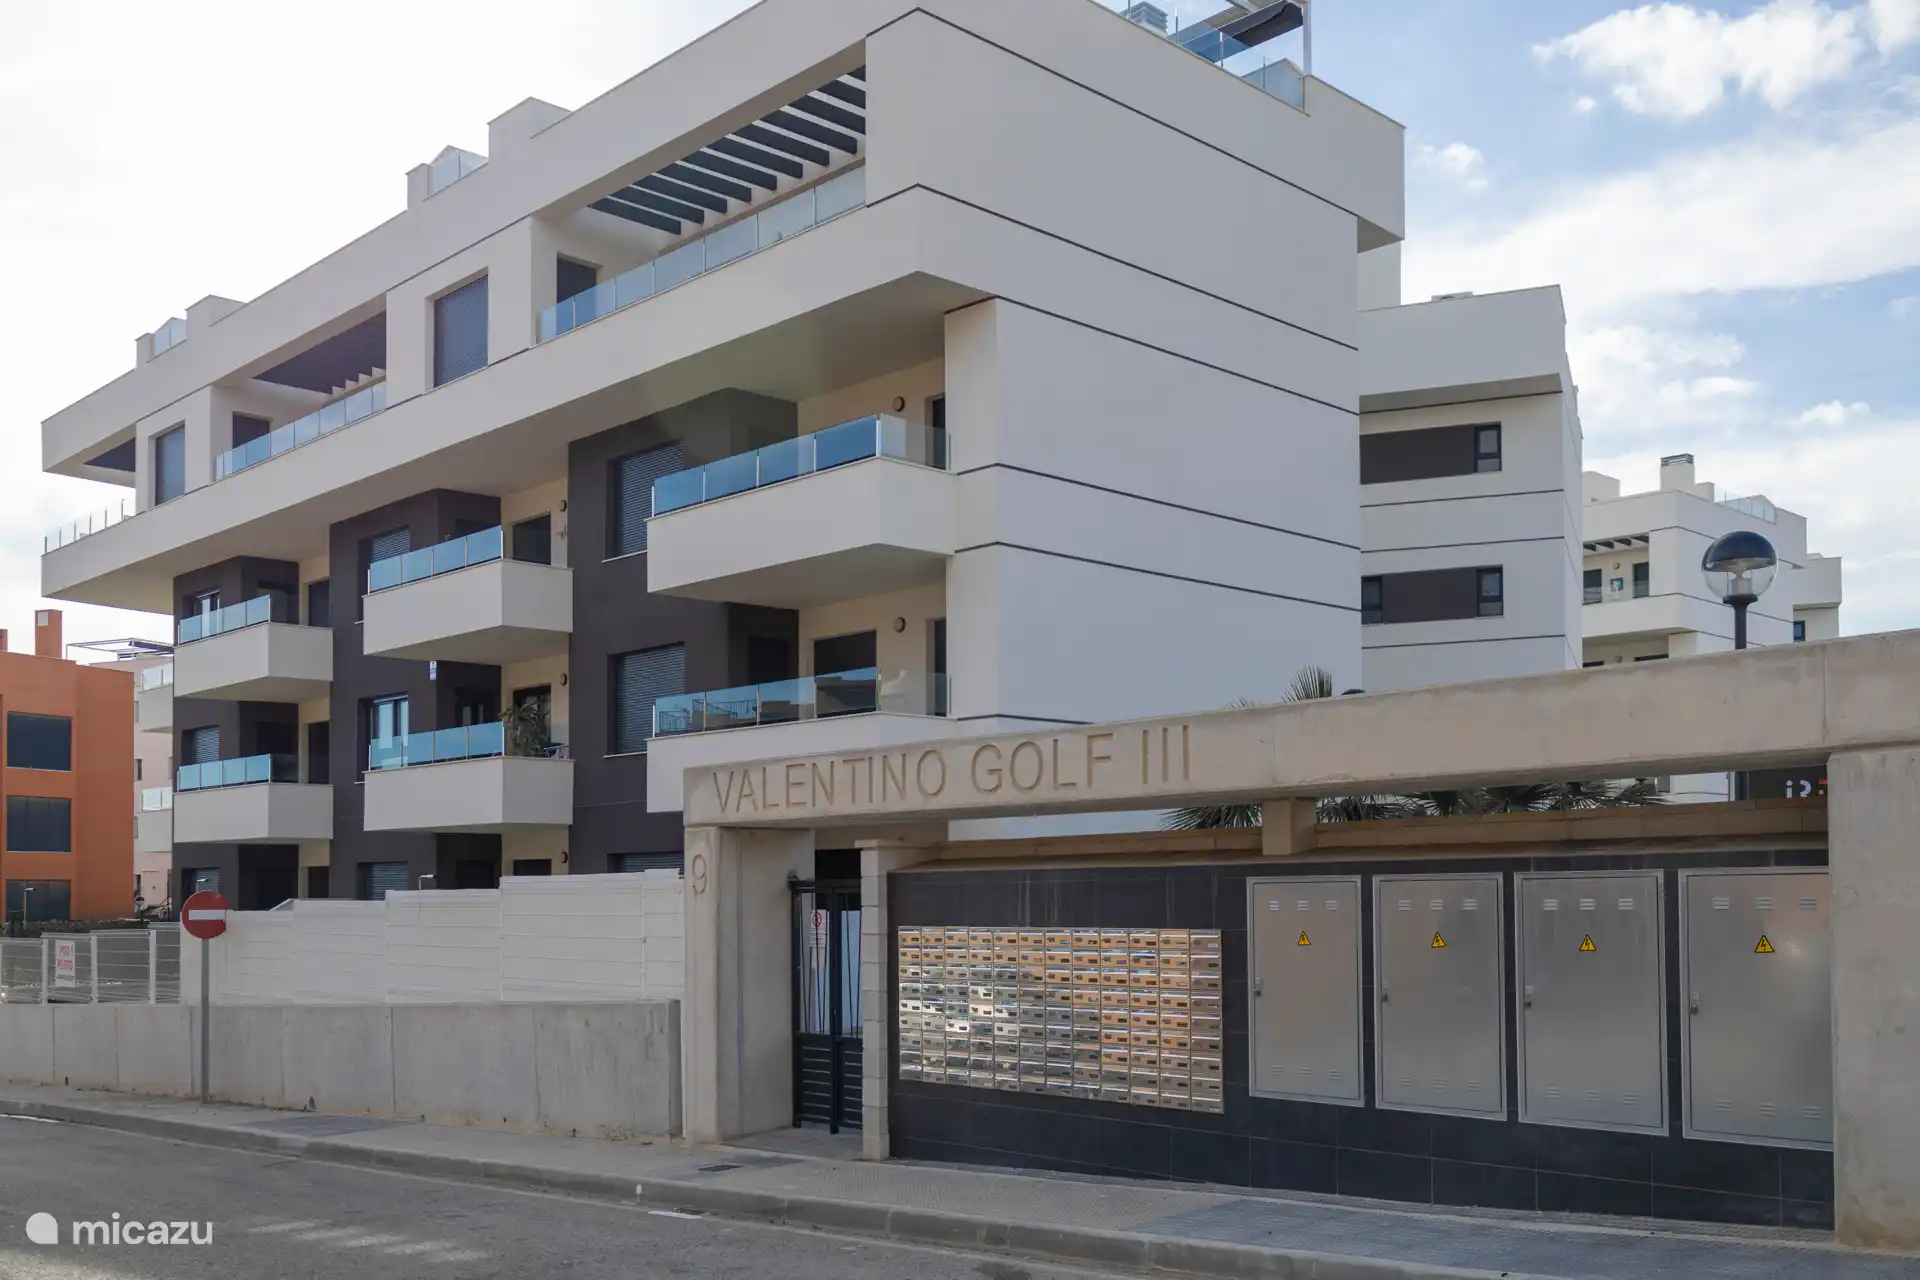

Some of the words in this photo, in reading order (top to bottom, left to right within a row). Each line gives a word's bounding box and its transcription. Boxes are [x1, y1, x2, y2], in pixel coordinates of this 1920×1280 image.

[713, 750, 947, 814] VALENTINO
[971, 732, 1114, 793] GOLF
[1142, 724, 1190, 786] III
[691, 853, 708, 895] 9
